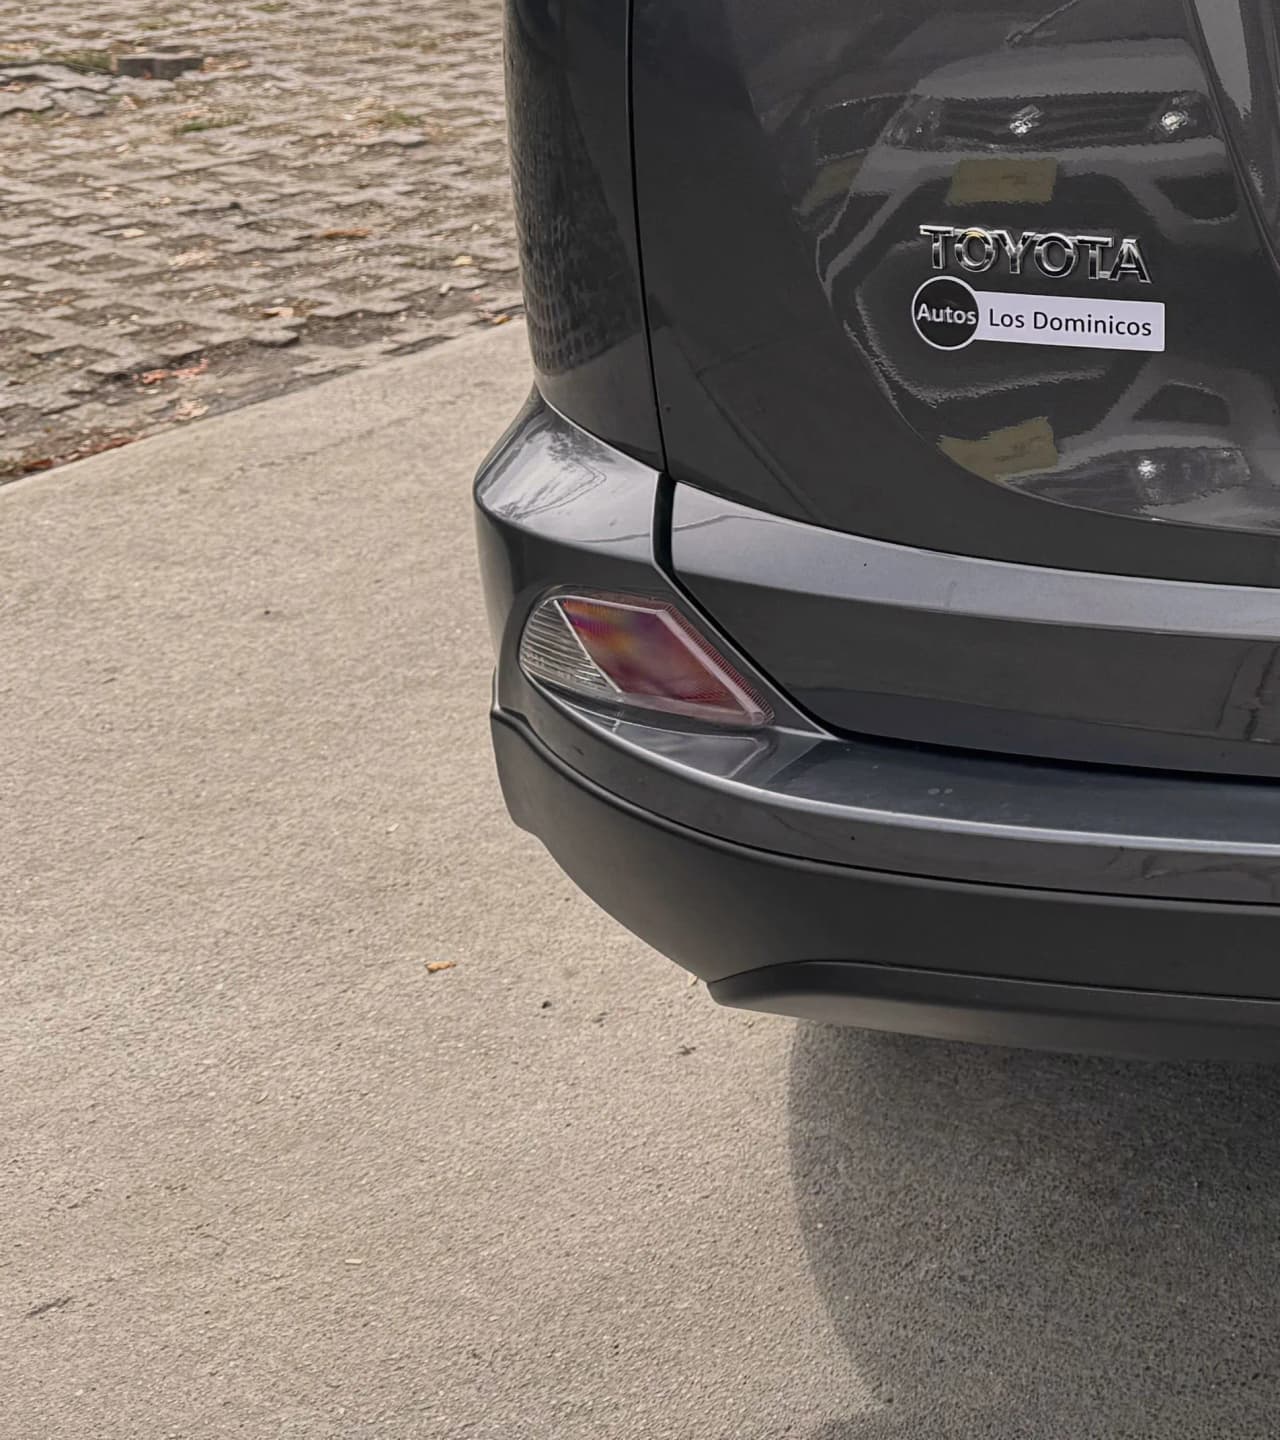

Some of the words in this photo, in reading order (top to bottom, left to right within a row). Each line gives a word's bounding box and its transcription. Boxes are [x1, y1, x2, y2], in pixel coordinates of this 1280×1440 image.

[919, 224, 1152, 284] TOYOTA
[916, 302, 977, 325] Autos
[988, 307, 1025, 329] Los
[1033, 310, 1152, 337] Dominicos
